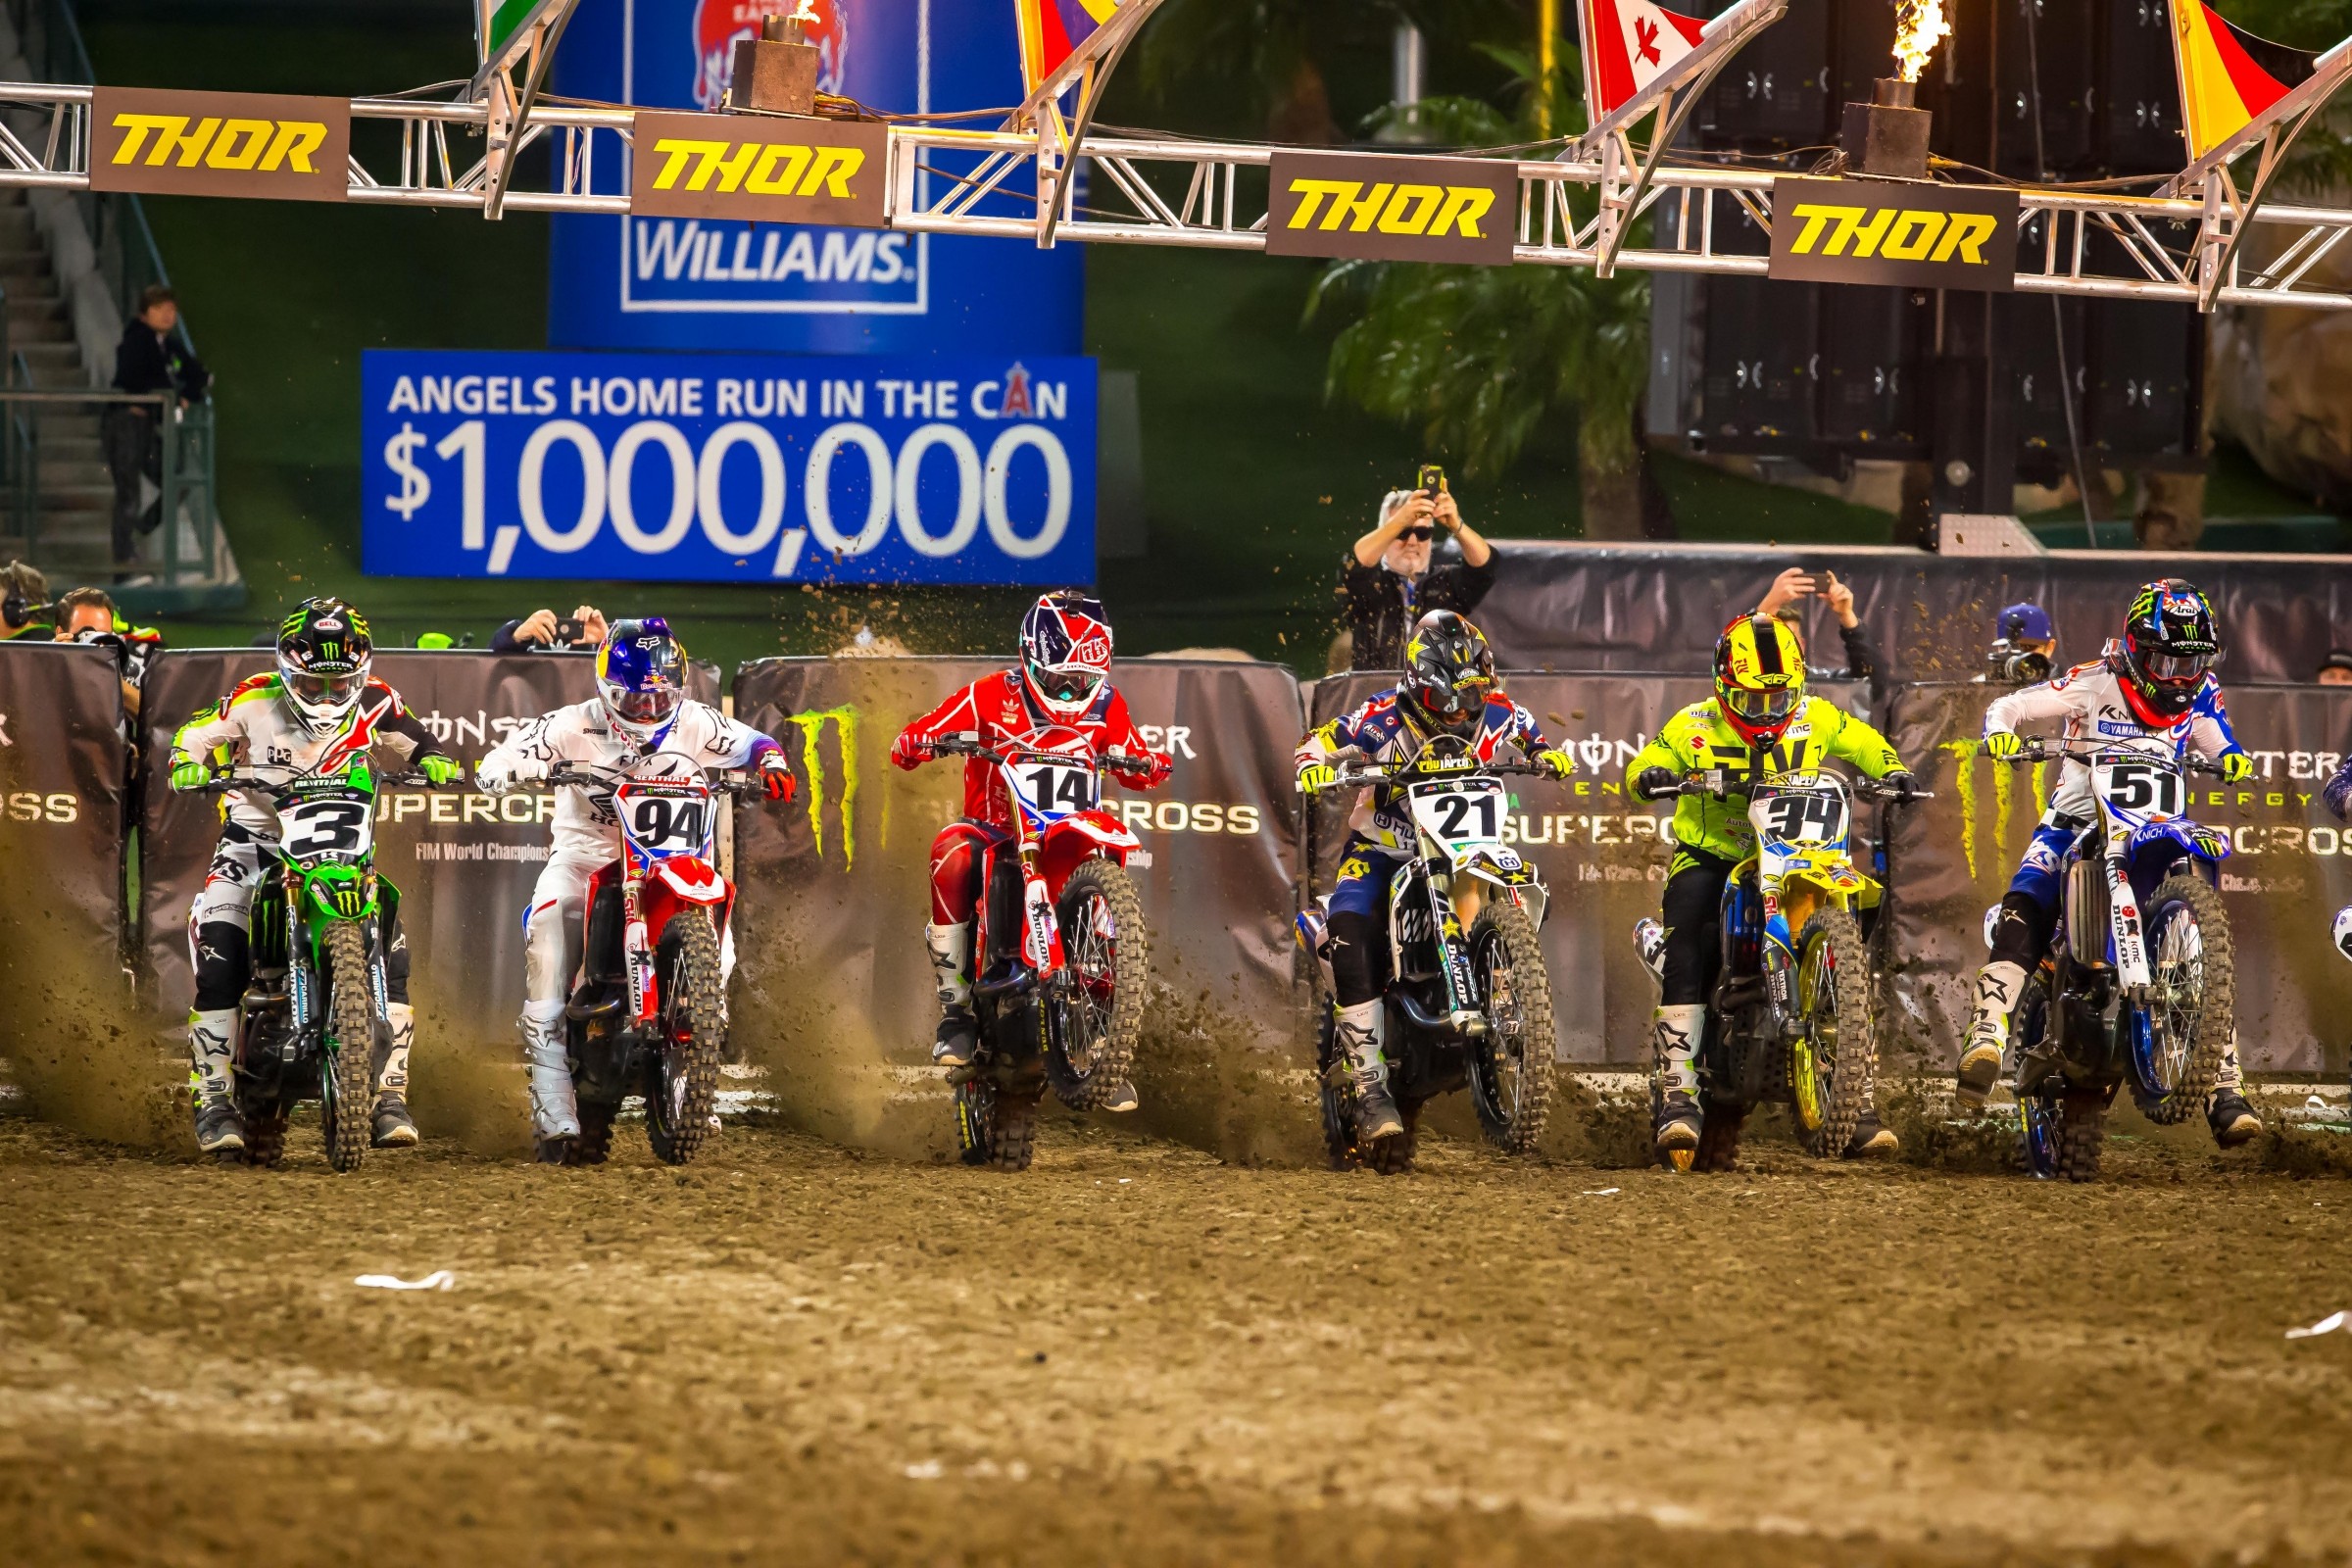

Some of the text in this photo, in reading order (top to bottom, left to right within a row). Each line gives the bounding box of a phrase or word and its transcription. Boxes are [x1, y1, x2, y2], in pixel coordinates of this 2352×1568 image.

[112, 113, 328, 173] THOR
[653, 139, 865, 199] THOR
[1287, 179, 1496, 238] THOR
[636, 220, 904, 282] WILLIAMS
[1790, 204, 1997, 264] THOR
[388, 361, 1067, 419] ANGELS HOME RUN IN THE CAN
[384, 419, 1072, 577] $1,000,000
[2174, 606, 2196, 614] Arai
[309, 661, 354, 670] MONSTER
[2171, 640, 2216, 649] MONSTER
[2111, 725, 2144, 737] YAMAHA
[269, 747, 292, 762] PPG
[1043, 756, 1074, 764] MONSTER
[2127, 756, 2161, 765] MONSTER
[295, 778, 348, 788] RENTHAL
[310, 792, 344, 801] MONSTER
[633, 774, 687, 783] RENTHAL
[1026, 766, 1093, 811] 14
[2110, 765, 2177, 815] 51
[290, 802, 366, 857] 3
[633, 799, 705, 849] 94
[1434, 795, 1496, 840] 21
[1764, 796, 1842, 842] 34
[416, 843, 440, 860] FIM
[444, 843, 483, 861] World
[204, 903, 250, 919] Kawasak
[1032, 913, 1050, 964] DUNLOP
[2113, 904, 2131, 969] DUNLOP
[2131, 941, 2141, 964] KMC
[371, 963, 381, 1003] CARRILLO
[630, 956, 643, 1012] DUNLOP
[1447, 943, 1468, 1004] DUNLOP
[1770, 974, 1781, 1018] DUNLOP
[1779, 968, 1788, 1001] TEXTRON
[1039, 998, 1050, 1053] DUNLOP
